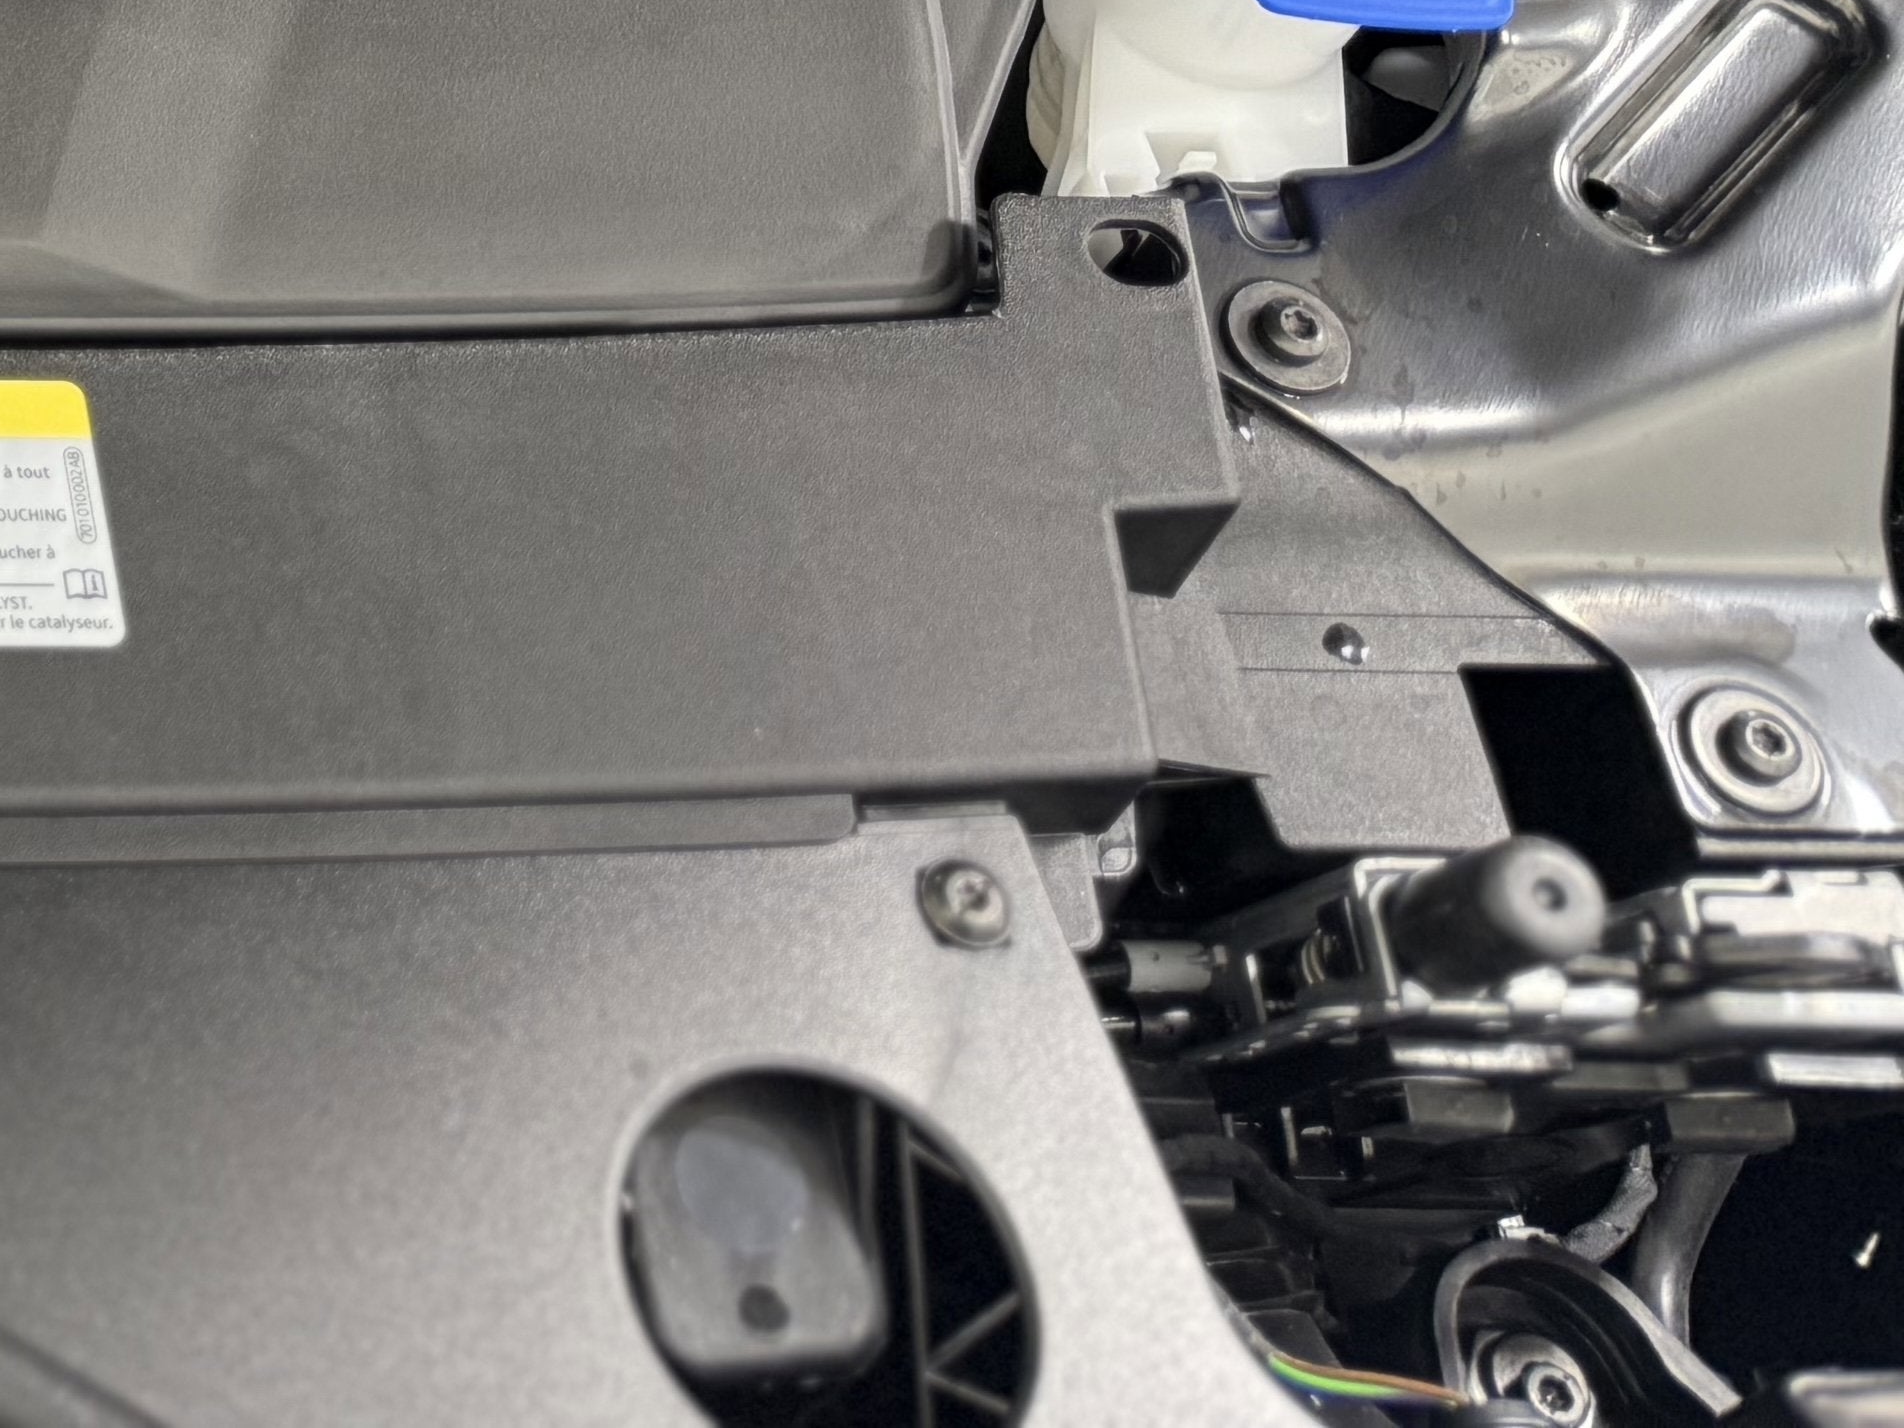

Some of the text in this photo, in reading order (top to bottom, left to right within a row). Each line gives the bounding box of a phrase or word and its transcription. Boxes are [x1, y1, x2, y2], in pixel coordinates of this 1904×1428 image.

[16, 466, 51, 479] tout
[9, 614, 25, 630] le
[28, 614, 114, 633] catalyseur.
